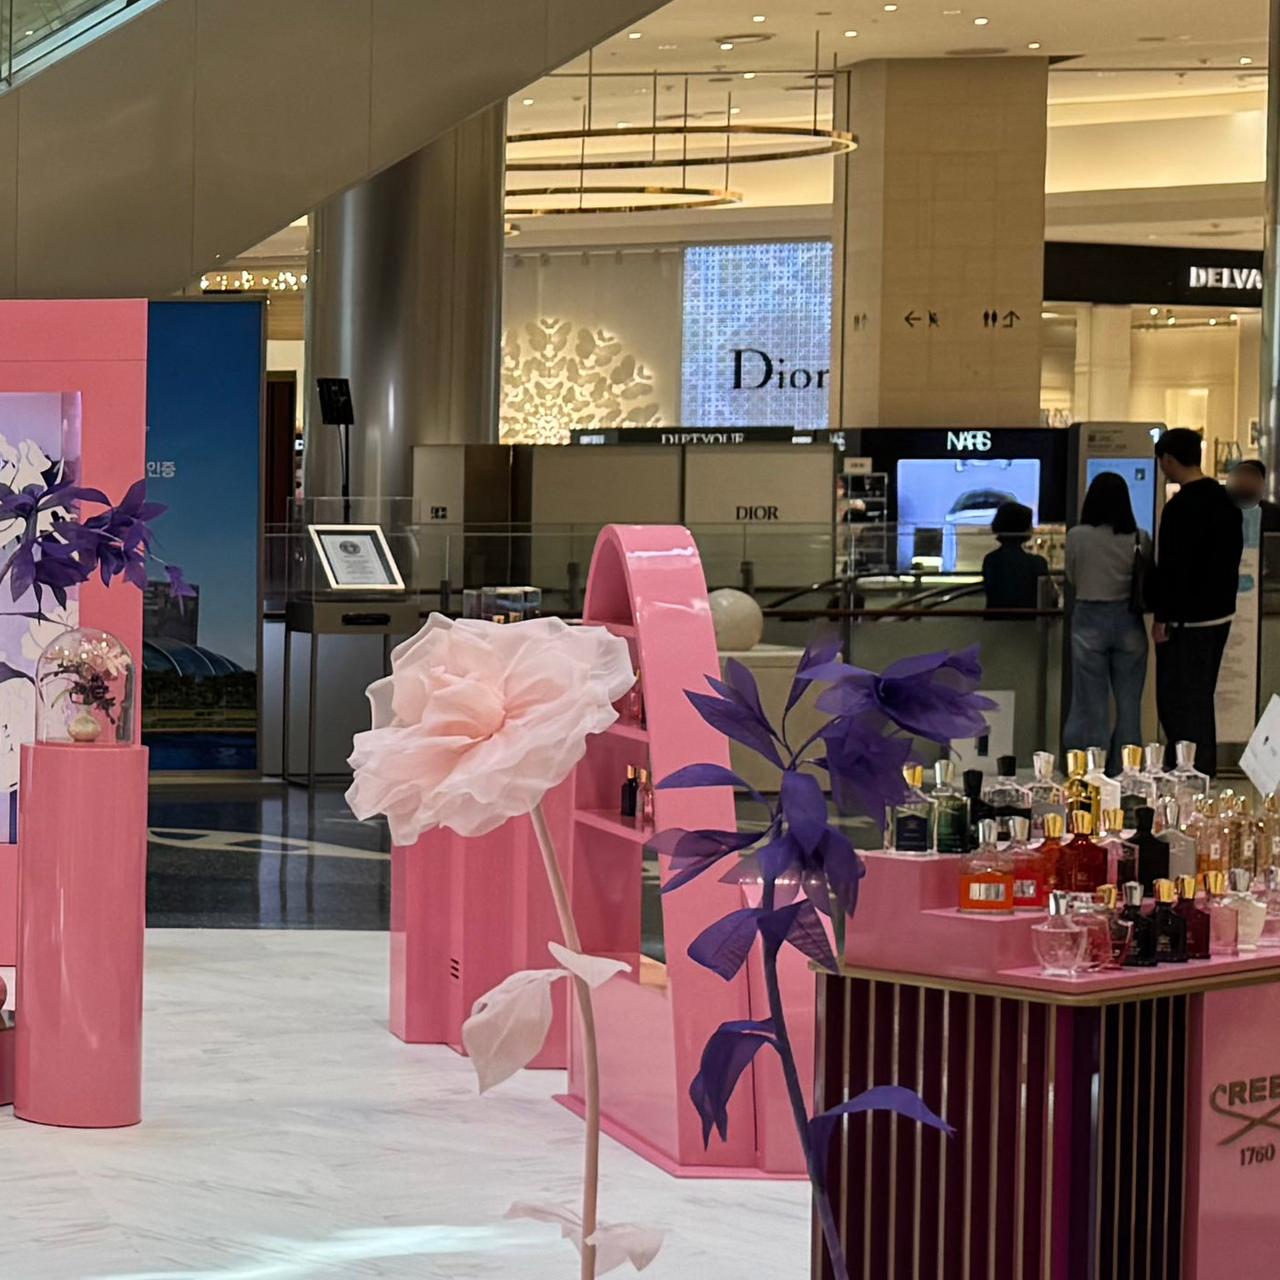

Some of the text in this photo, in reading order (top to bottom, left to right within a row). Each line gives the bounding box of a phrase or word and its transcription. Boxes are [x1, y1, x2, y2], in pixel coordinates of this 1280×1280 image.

[1189, 266, 1263, 290] DELVA
[729, 348, 830, 389] Dior
[947, 431, 992, 451] NARS
[146, 461, 177, 478] 인증
[736, 505, 778, 520] DIOR
[1210, 1075, 1280, 1120] CREE
[1240, 1144, 1276, 1166] 1760
